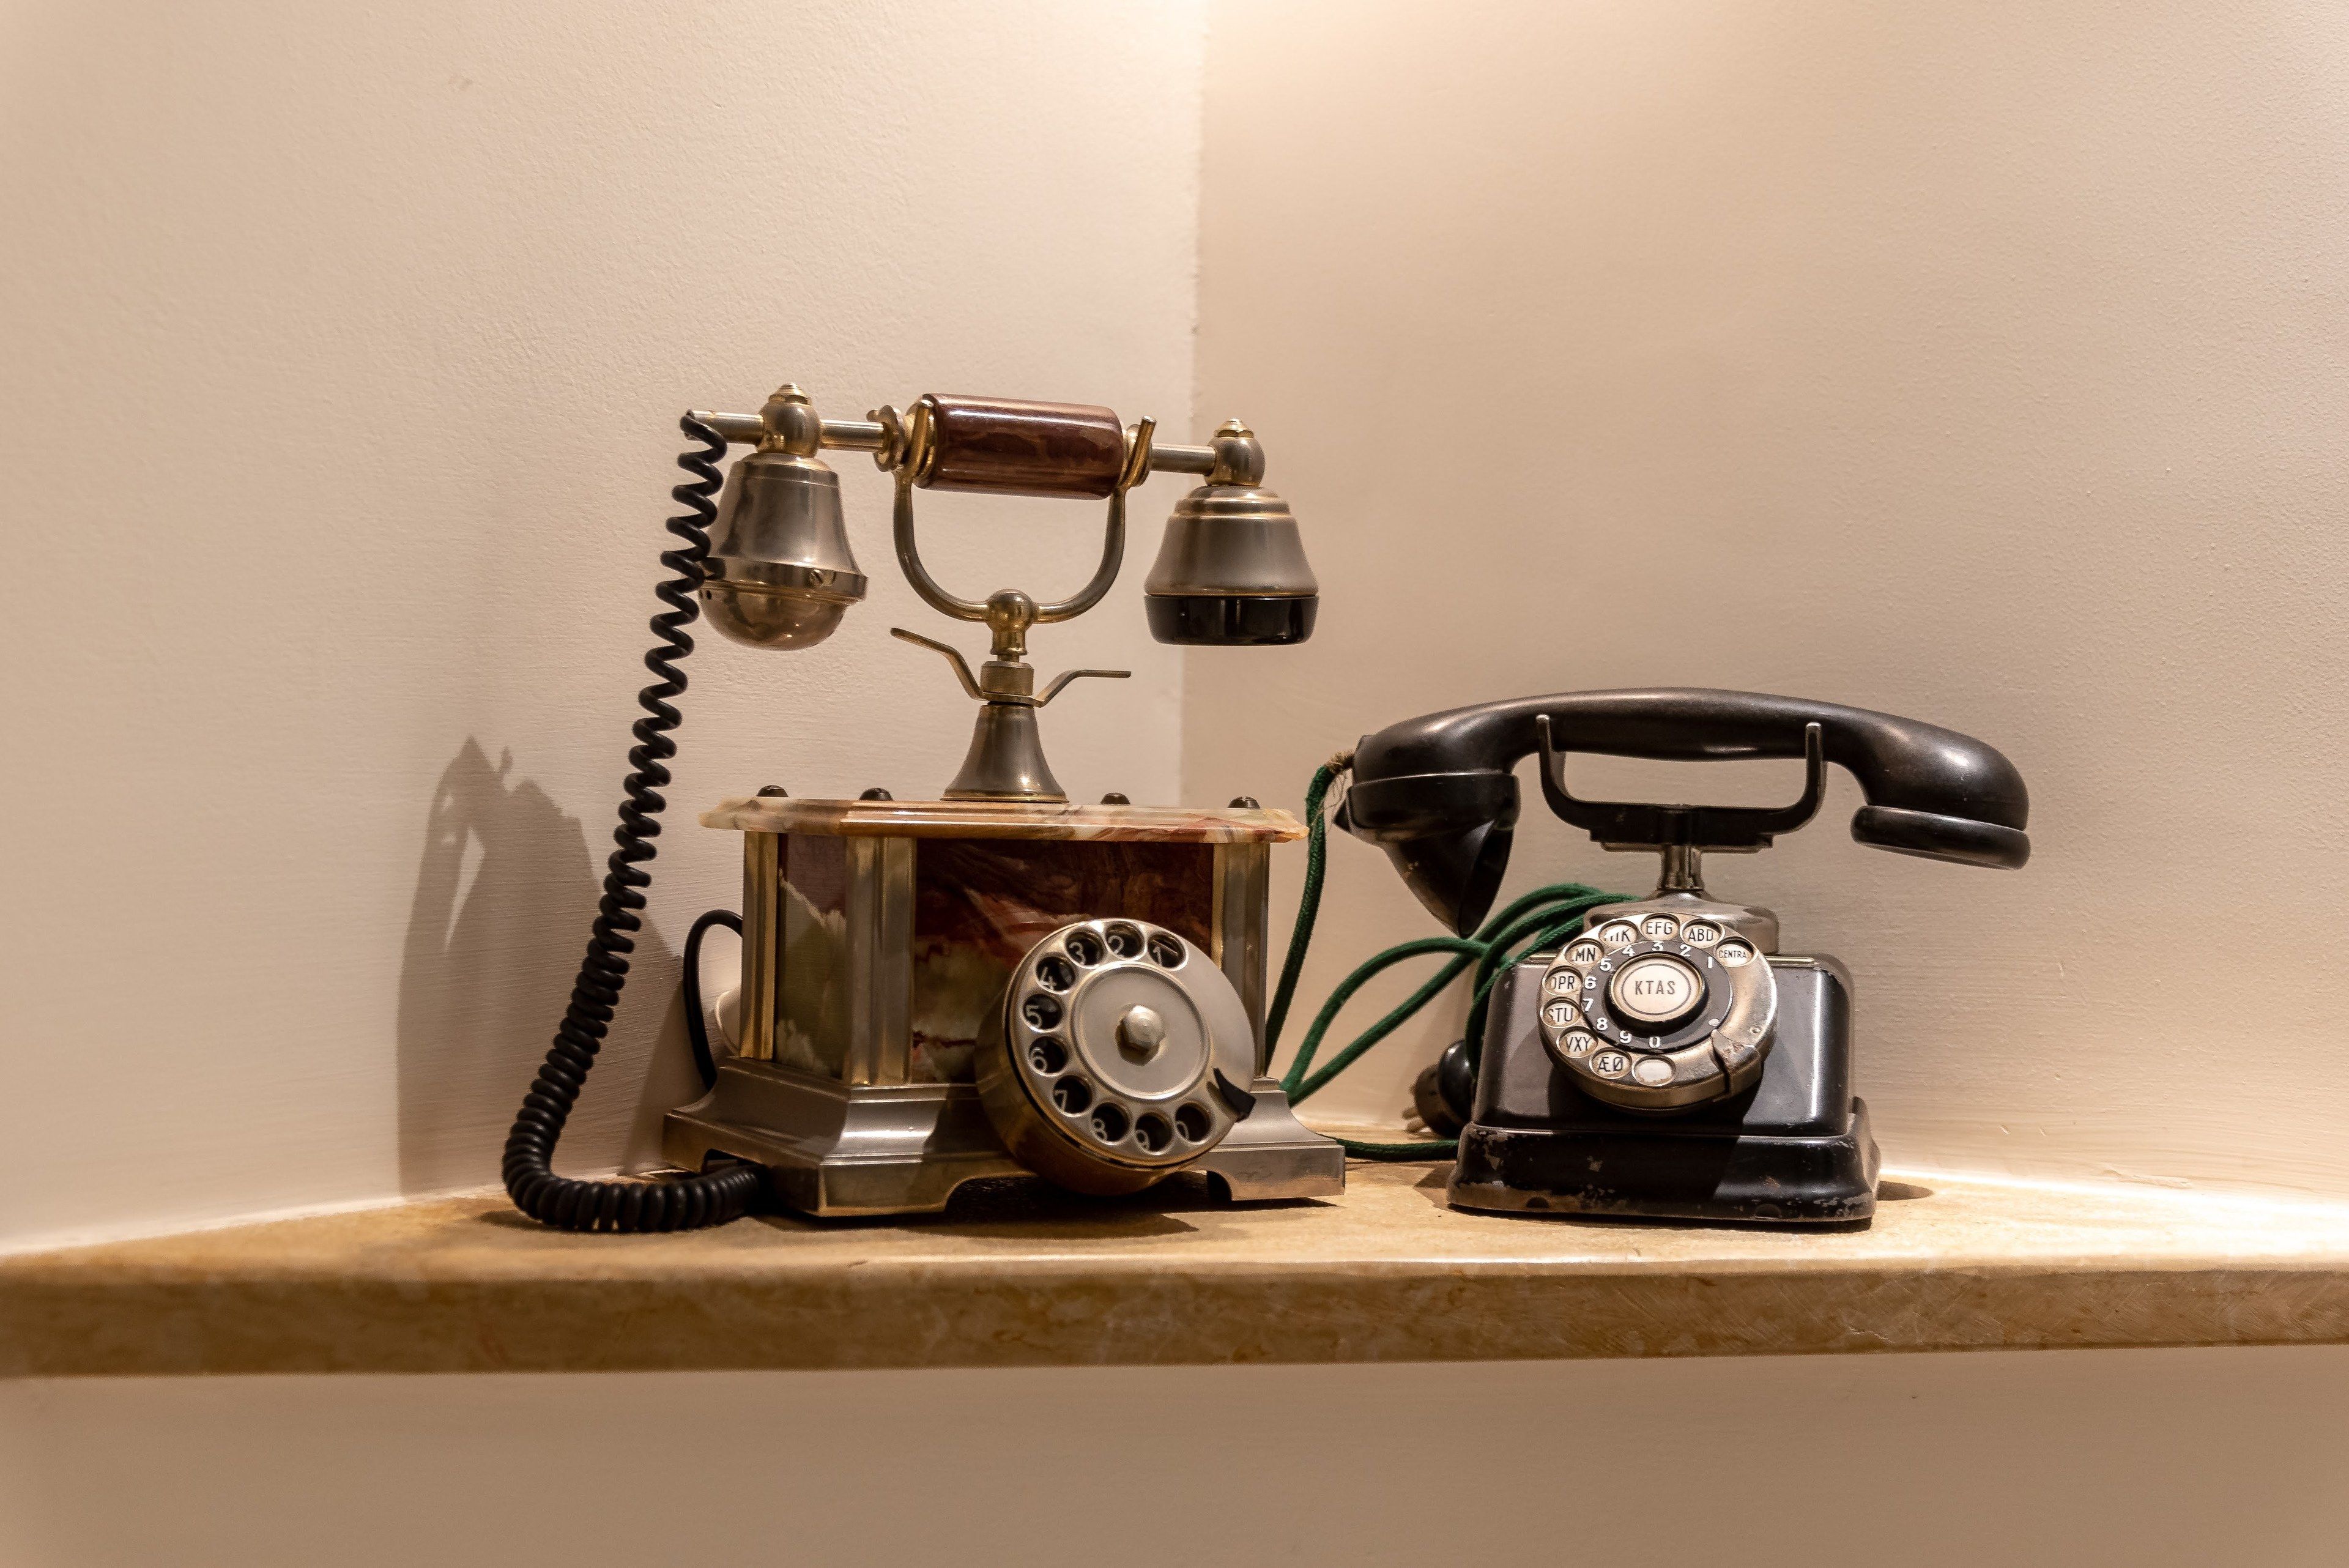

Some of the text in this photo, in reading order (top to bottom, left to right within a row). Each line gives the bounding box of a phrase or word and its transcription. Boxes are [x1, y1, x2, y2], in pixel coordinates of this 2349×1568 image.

[1604, 928, 1630, 942] IK
[1646, 921, 1672, 935] EFG
[1688, 928, 1713, 942] ABD
[1108, 935, 1124, 957] 2
[1622, 945, 1635, 957] 4
[1652, 940, 1664, 951] 3
[1679, 944, 1691, 957] 2
[1069, 942, 1086, 966] 3
[1572, 947, 1596, 962] MN
[1600, 958, 1612, 972] 5
[1707, 956, 1713, 969] 1
[1040, 967, 1057, 990] 4
[1584, 976, 1597, 989] 6
[1635, 980, 1675, 995] KTAS
[1583, 998, 1594, 1011] 7
[1026, 1004, 1042, 1029] 5
[1546, 1007, 1573, 1022] STU
[1596, 1017, 1608, 1031] 8
[1566, 1036, 1591, 1052] VXY
[1619, 1030, 1632, 1044] 9
[1649, 1036, 1661, 1049] 0
[1030, 1047, 1048, 1071] 6
[1597, 1057, 1623, 1073] ÆØ
[1054, 1090, 1067, 1110] 7
[1092, 1118, 1107, 1140] 8
[1175, 1120, 1189, 1140] 0
[1135, 1129, 1150, 1151] 9
